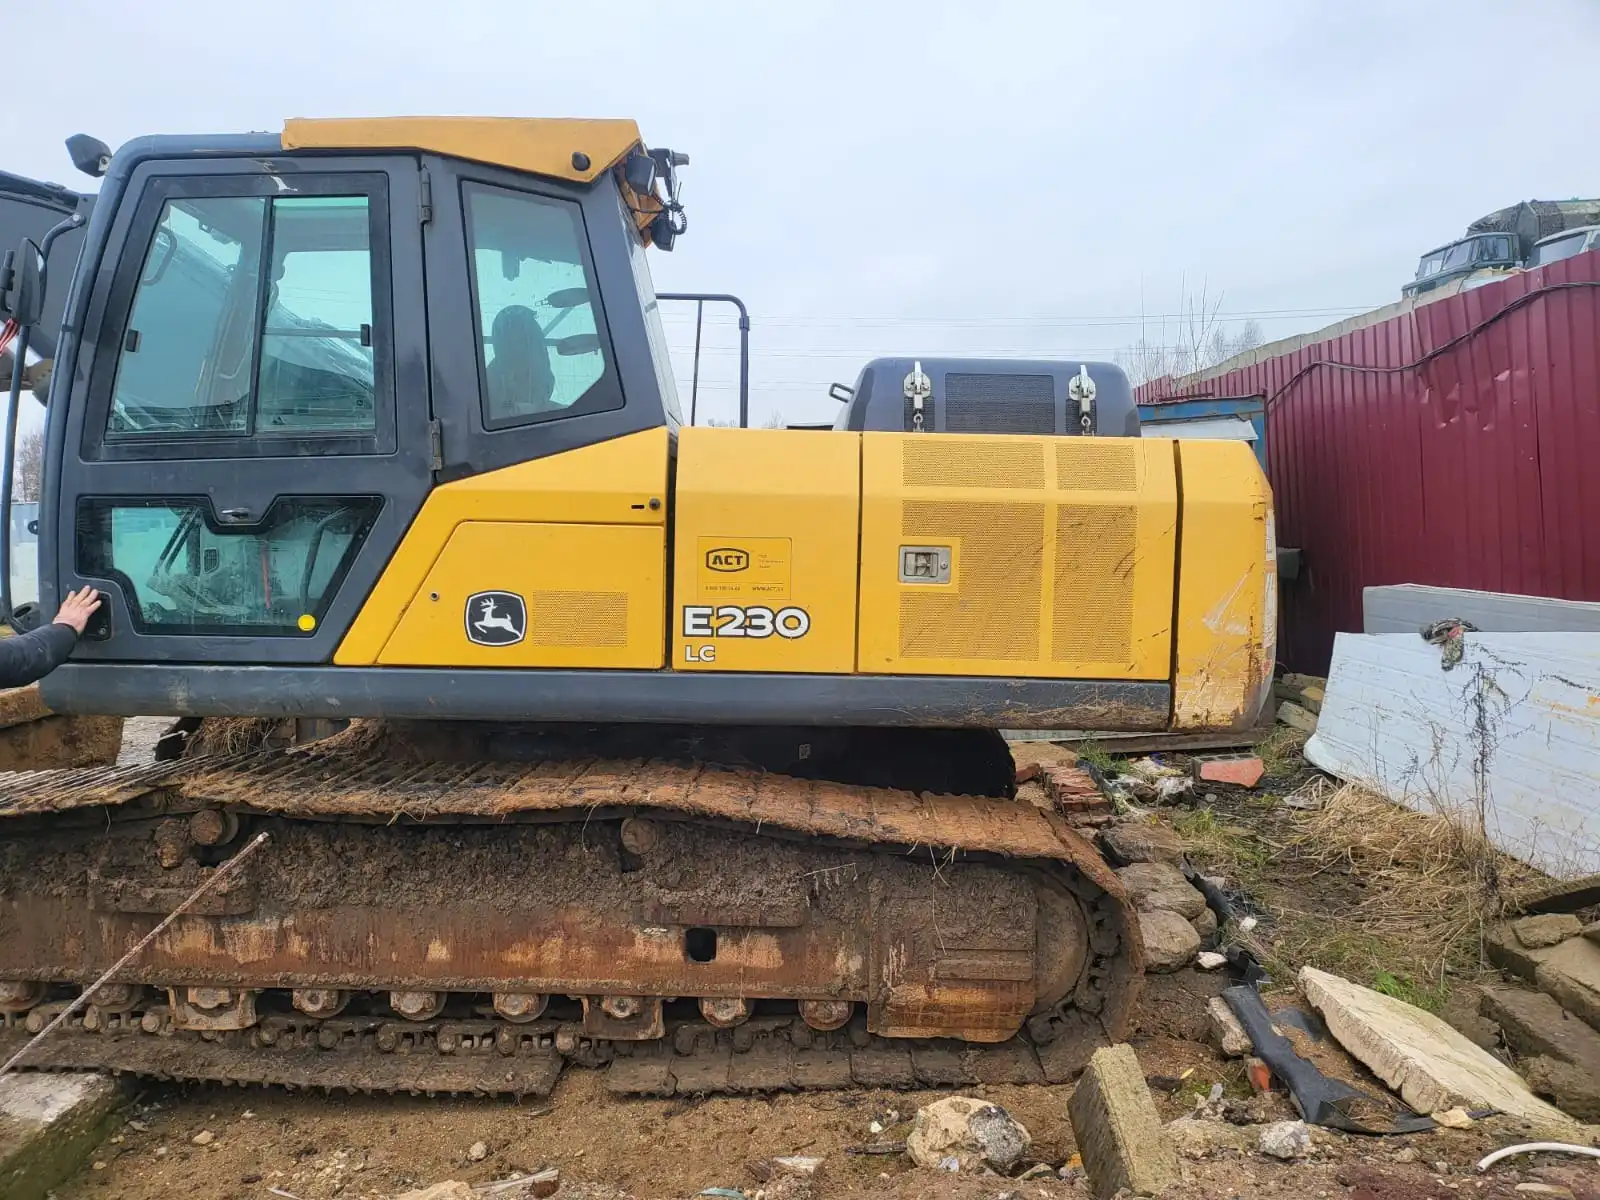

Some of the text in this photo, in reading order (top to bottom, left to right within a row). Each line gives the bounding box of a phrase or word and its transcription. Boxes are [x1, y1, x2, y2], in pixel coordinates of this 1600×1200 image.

[712, 555, 743, 566] ACT
[683, 605, 811, 639] E230
[685, 645, 716, 662] LC
